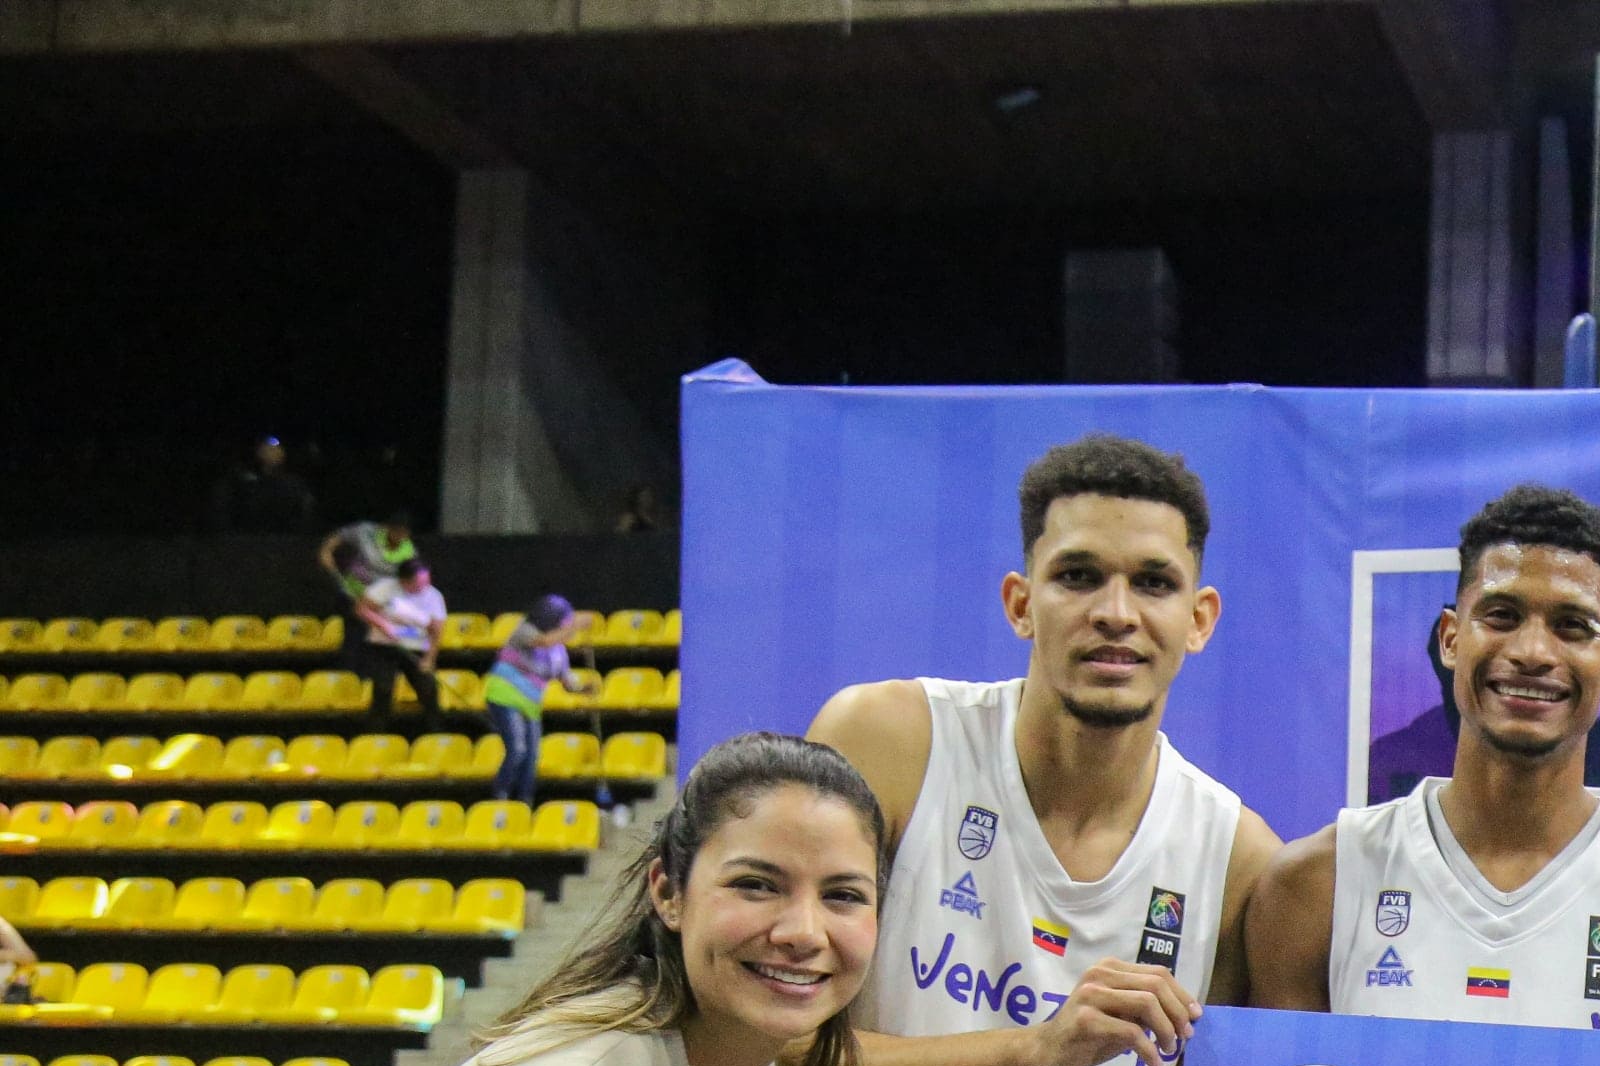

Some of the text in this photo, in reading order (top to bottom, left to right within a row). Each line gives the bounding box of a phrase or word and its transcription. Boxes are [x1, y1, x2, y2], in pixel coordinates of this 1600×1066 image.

[970, 812, 994, 828] FVB
[939, 888, 986, 920] PEAK
[1383, 896, 1406, 906] FVB
[1145, 936, 1175, 956] FIBA
[1366, 969, 1414, 987] PEAK
